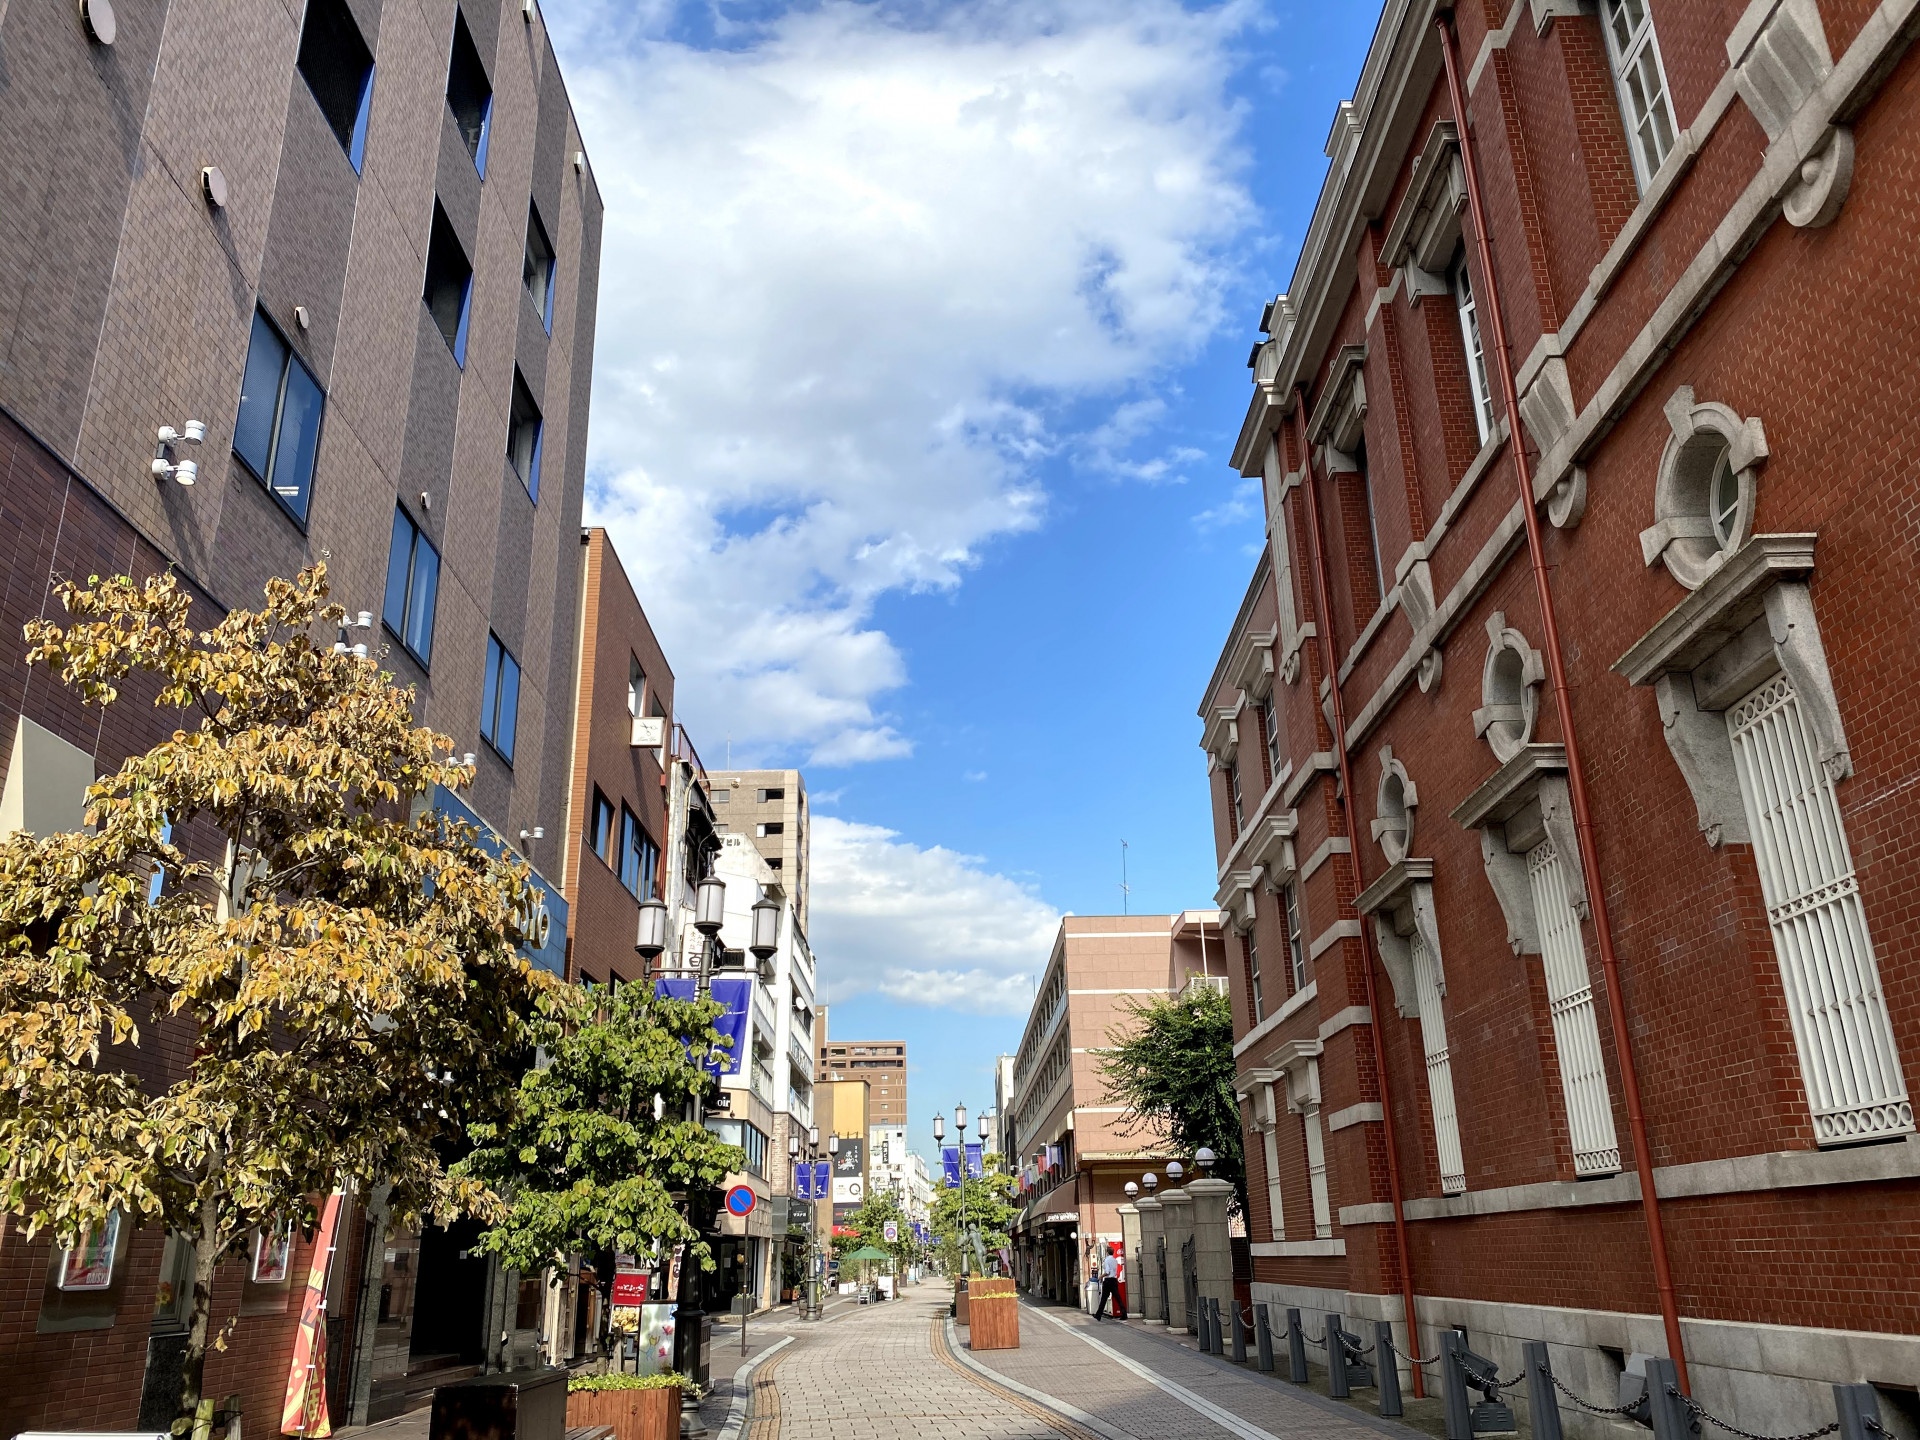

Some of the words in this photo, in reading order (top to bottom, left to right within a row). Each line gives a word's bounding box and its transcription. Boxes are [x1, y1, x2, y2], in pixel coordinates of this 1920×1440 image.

[967, 1163, 975, 1175] 5
[946, 1172, 952, 1184] 5
[797, 1185, 804, 1196] 5
[815, 1185, 822, 1196] 5
